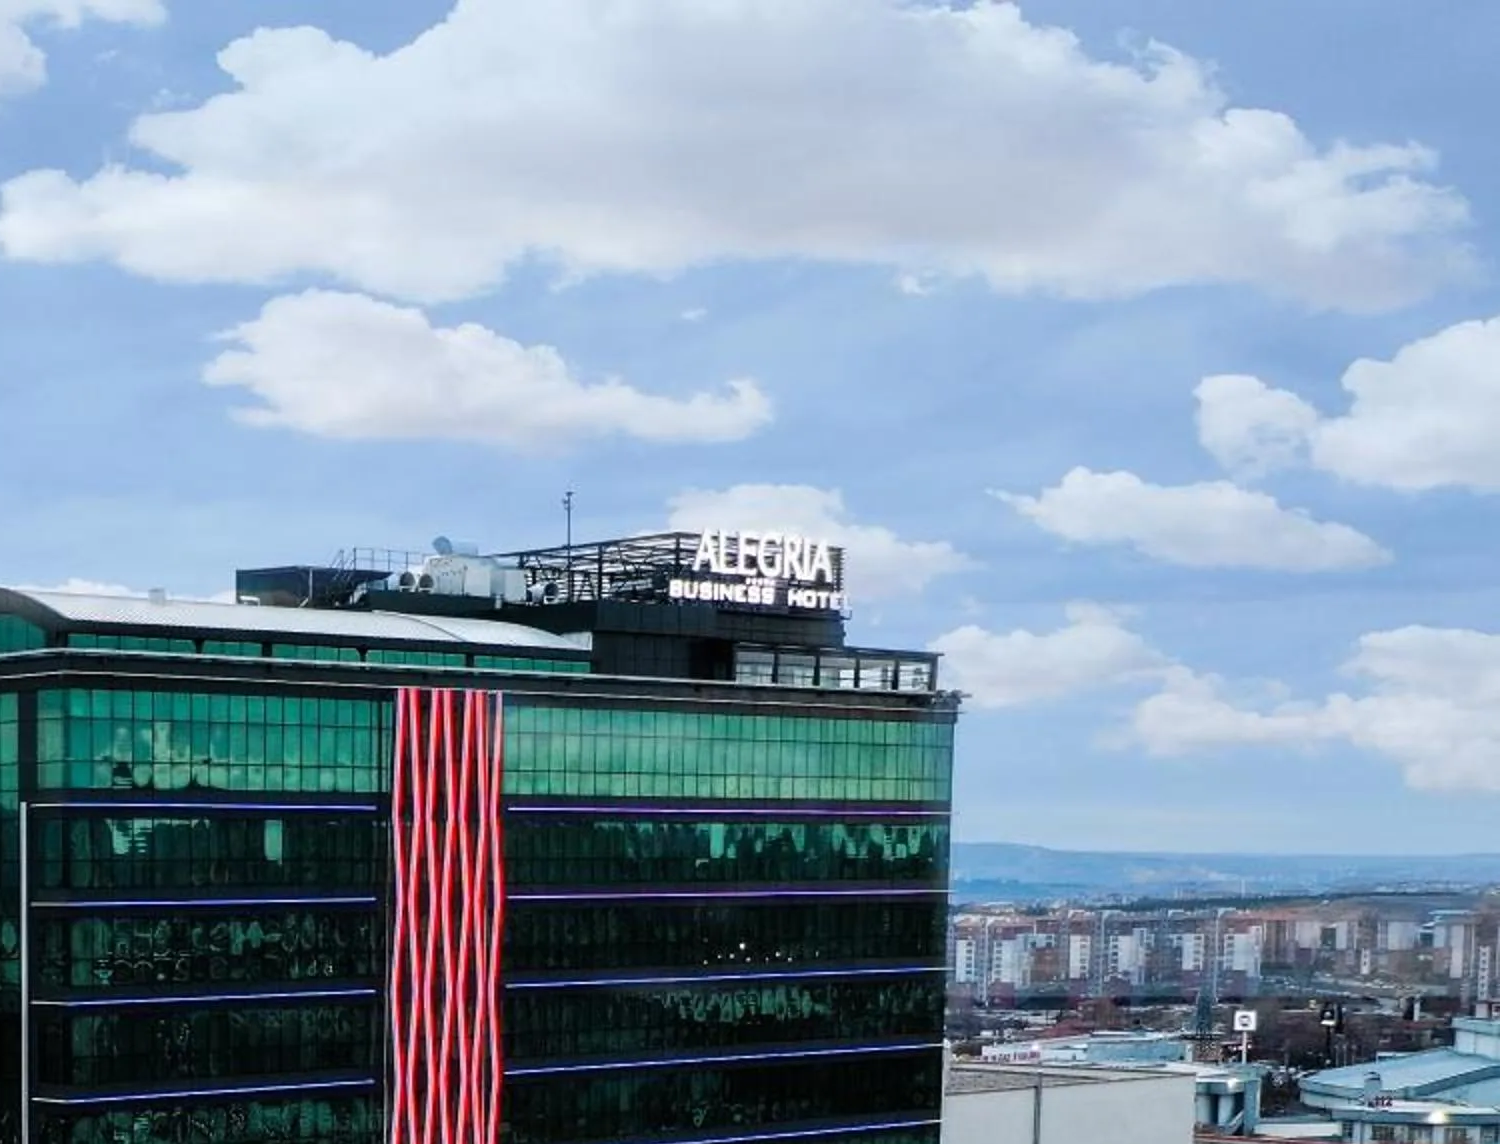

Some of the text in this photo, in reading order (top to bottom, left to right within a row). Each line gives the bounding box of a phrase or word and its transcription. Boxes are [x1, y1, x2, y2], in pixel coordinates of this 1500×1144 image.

[693, 528, 833, 583] ALEGRIA
[669, 579, 852, 610] BUSINESS HOTEL
